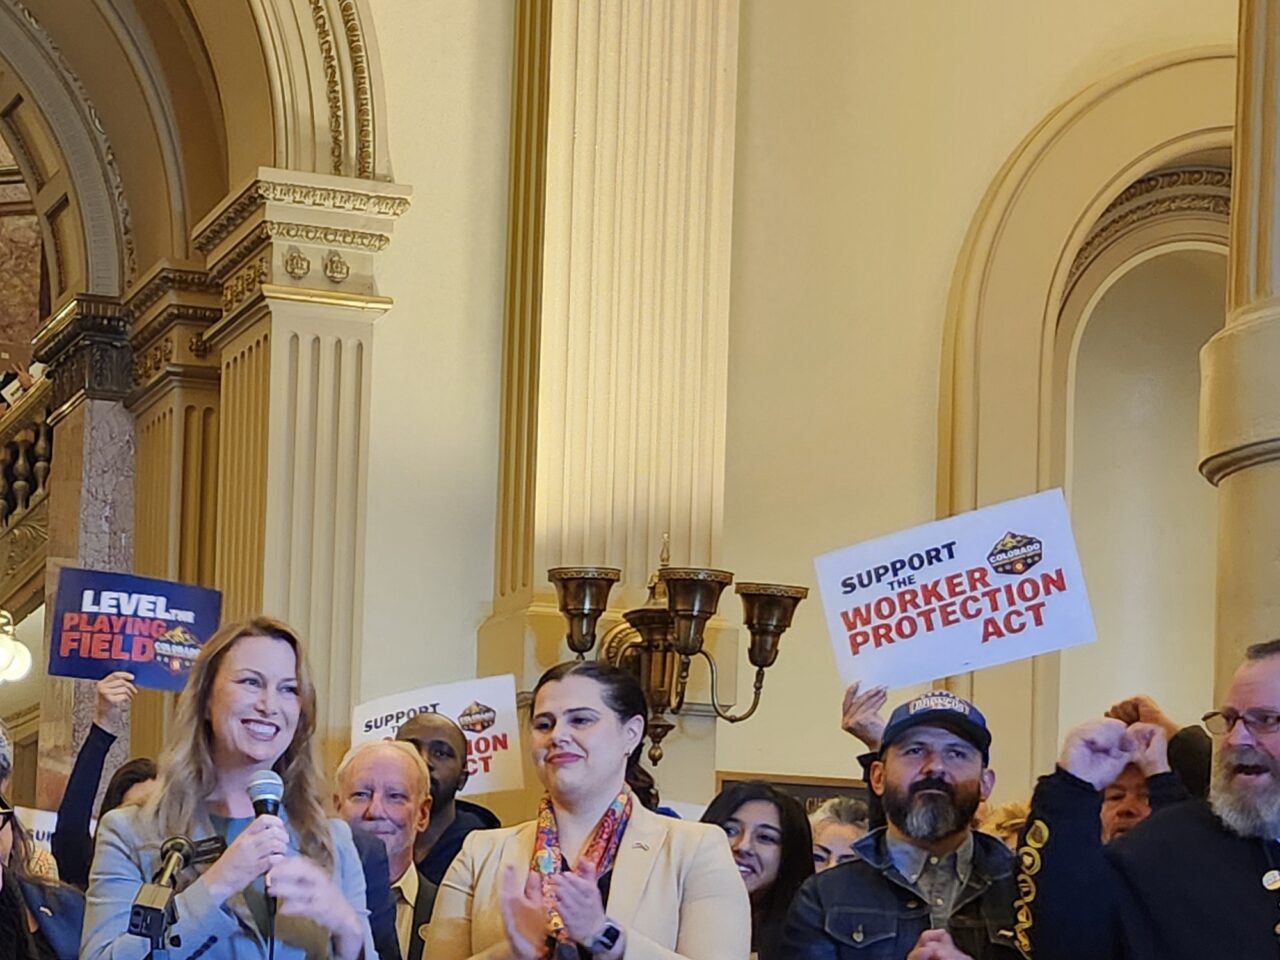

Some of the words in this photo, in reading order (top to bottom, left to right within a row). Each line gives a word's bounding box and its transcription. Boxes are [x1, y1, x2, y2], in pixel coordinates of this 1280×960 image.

[841, 541, 957, 594] SUPPORT
[887, 575, 916, 591] THE
[82, 590, 173, 621] LEVEL
[840, 567, 992, 632] WORKER
[848, 569, 1067, 656] PROTECTION
[63, 613, 167, 637] PLAYING
[981, 602, 1046, 643] ACT
[60, 632, 155, 662] FIELD
